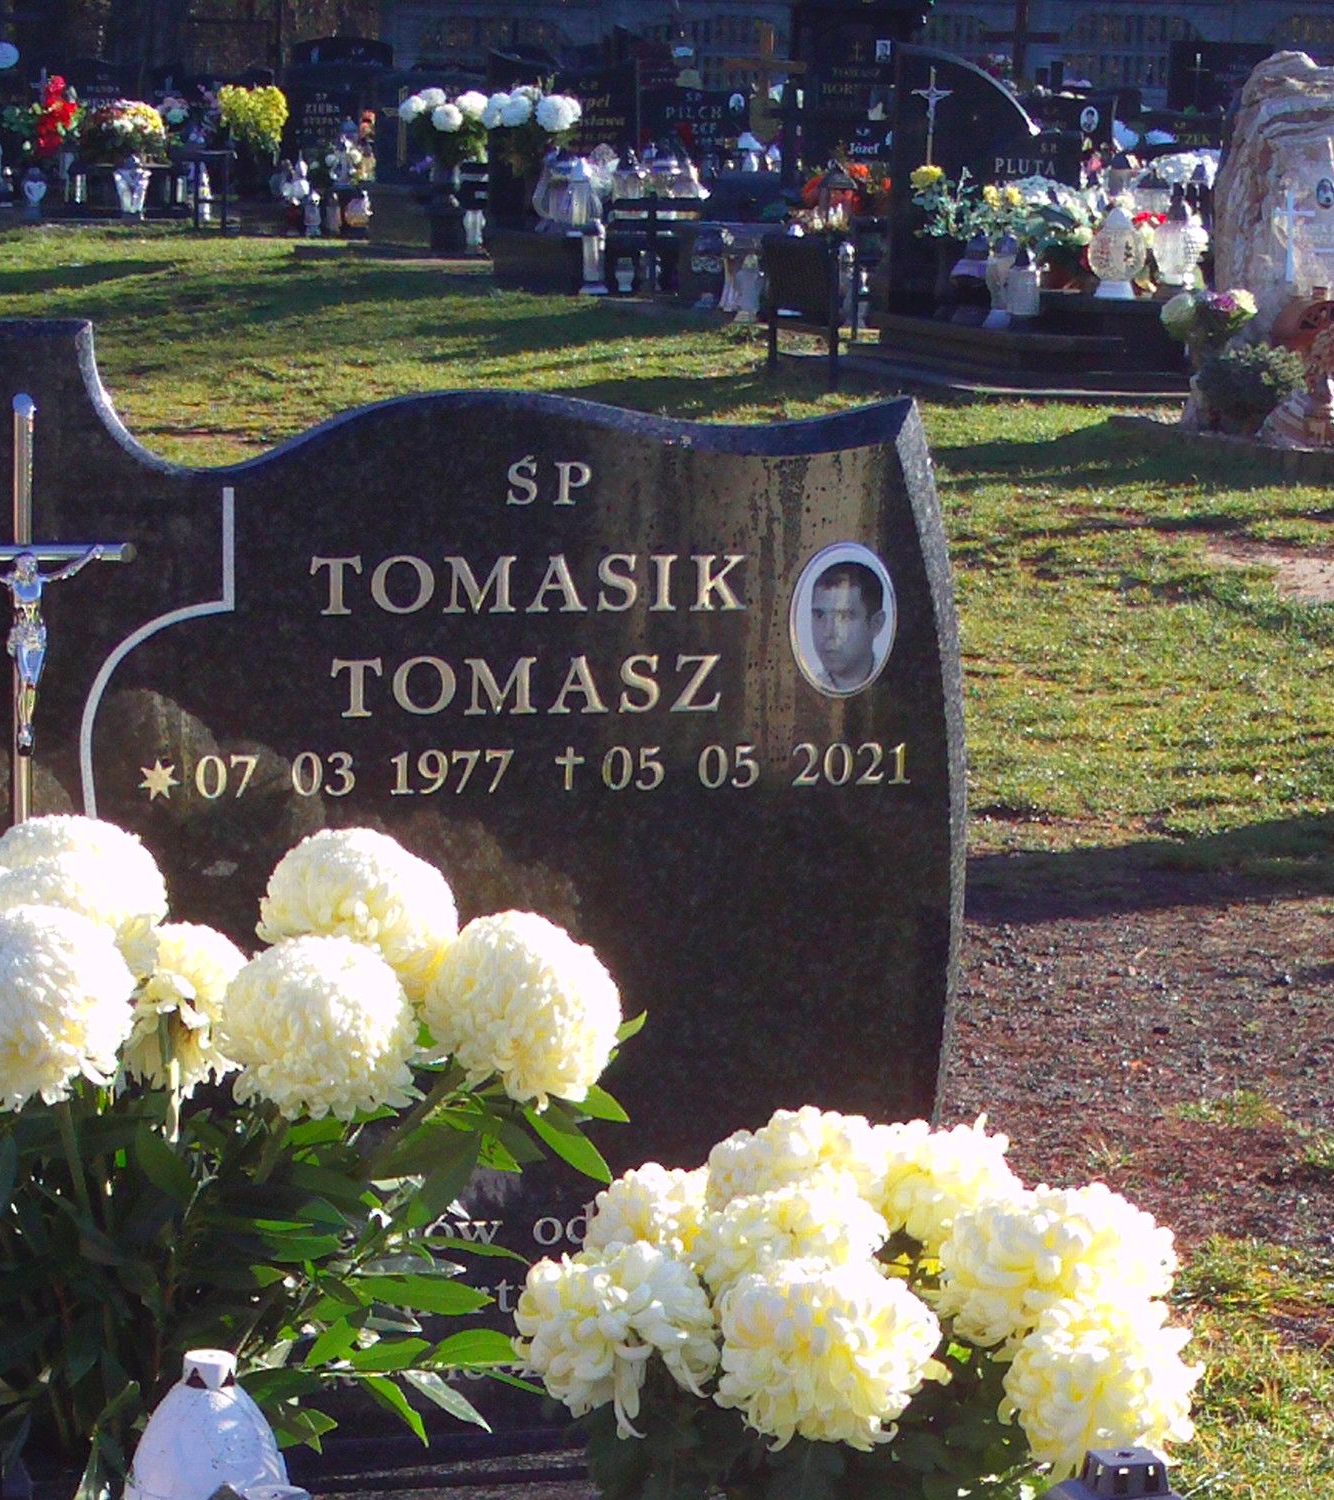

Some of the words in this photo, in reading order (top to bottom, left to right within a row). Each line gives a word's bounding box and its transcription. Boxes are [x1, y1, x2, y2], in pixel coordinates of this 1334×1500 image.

[994, 157, 1056, 176] PLUTA
[310, 553, 748, 617] TOMASIK
[330, 653, 723, 719] TOMASZ
[195, 754, 257, 800] 07
[290, 751, 356, 798] 03
[389, 748, 515, 797] 1977
[602, 745, 665, 791] 05
[697, 742, 760, 789] 05
[791, 740, 911, 788] 2021
